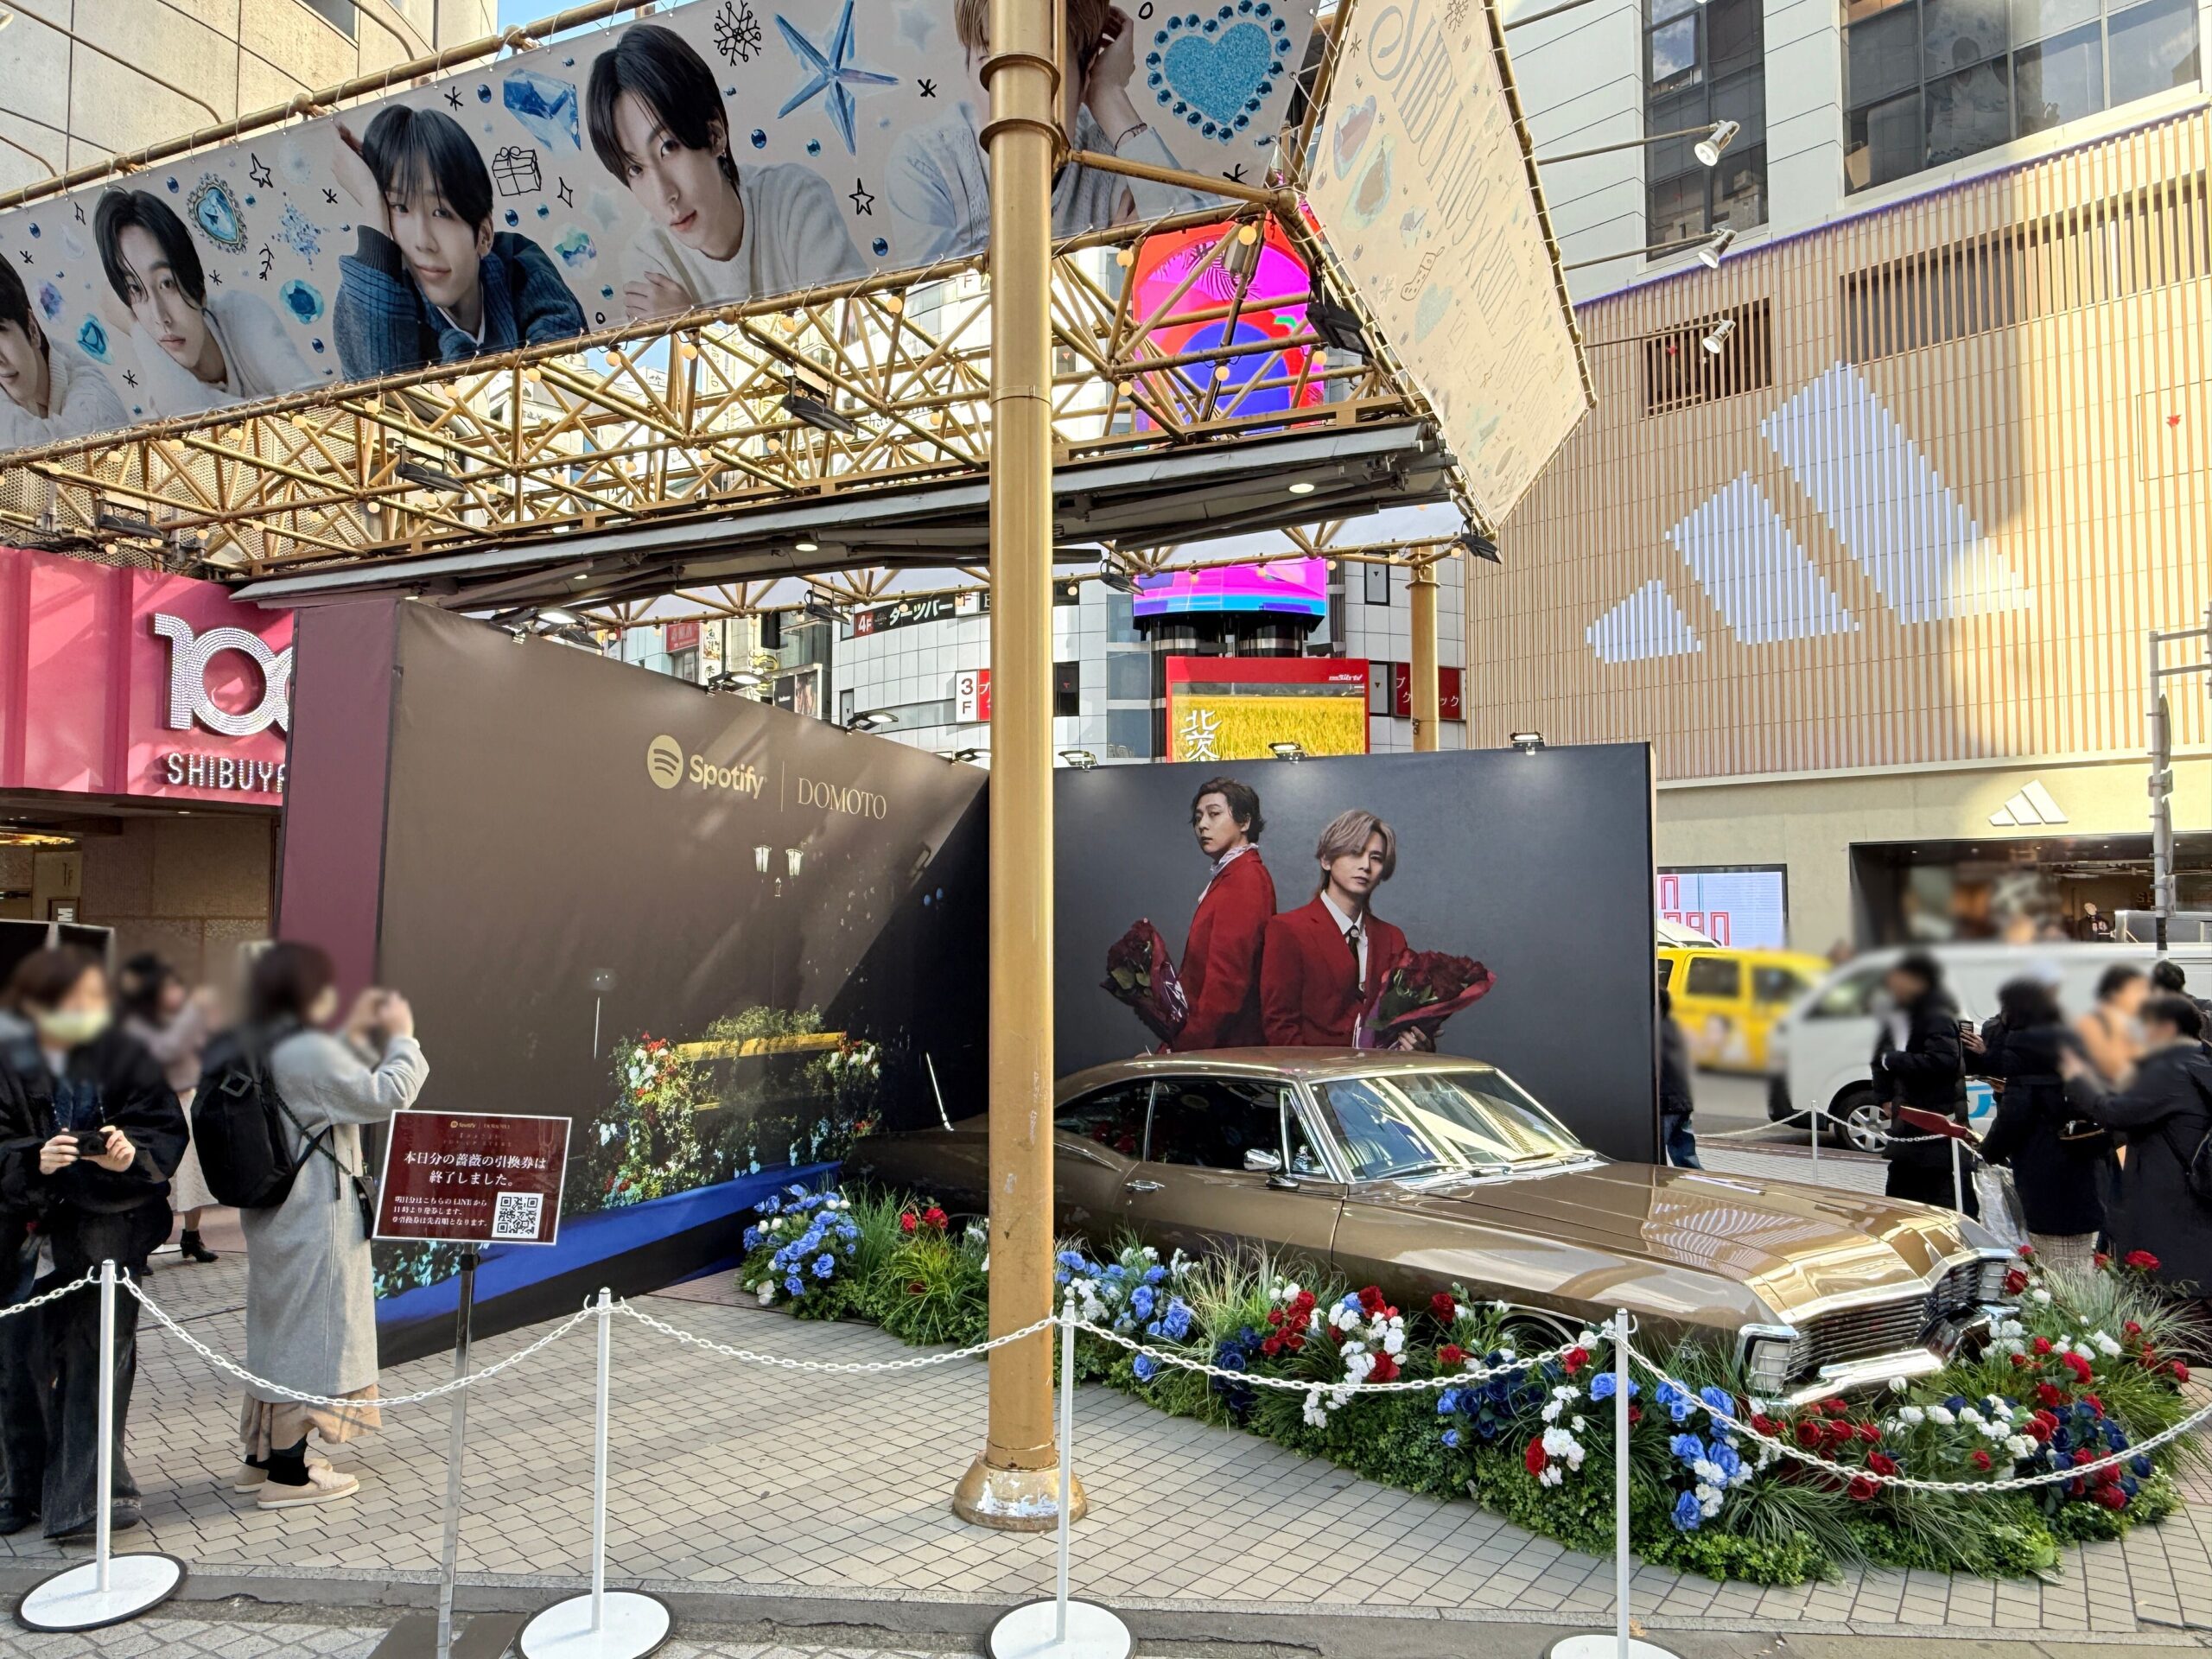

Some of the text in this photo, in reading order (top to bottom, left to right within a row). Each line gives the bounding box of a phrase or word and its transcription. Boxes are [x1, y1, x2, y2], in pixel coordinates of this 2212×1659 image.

[858, 614, 873, 632] 4F
[155, 613, 292, 736] 10
[1179, 709, 1222, 761] 北茨
[690, 754, 887, 810] Spotify DOMOTO
[404, 1151, 547, 1169] 本日分の薔薇の引換券は
[429, 1171, 513, 1187] 終了しました。
